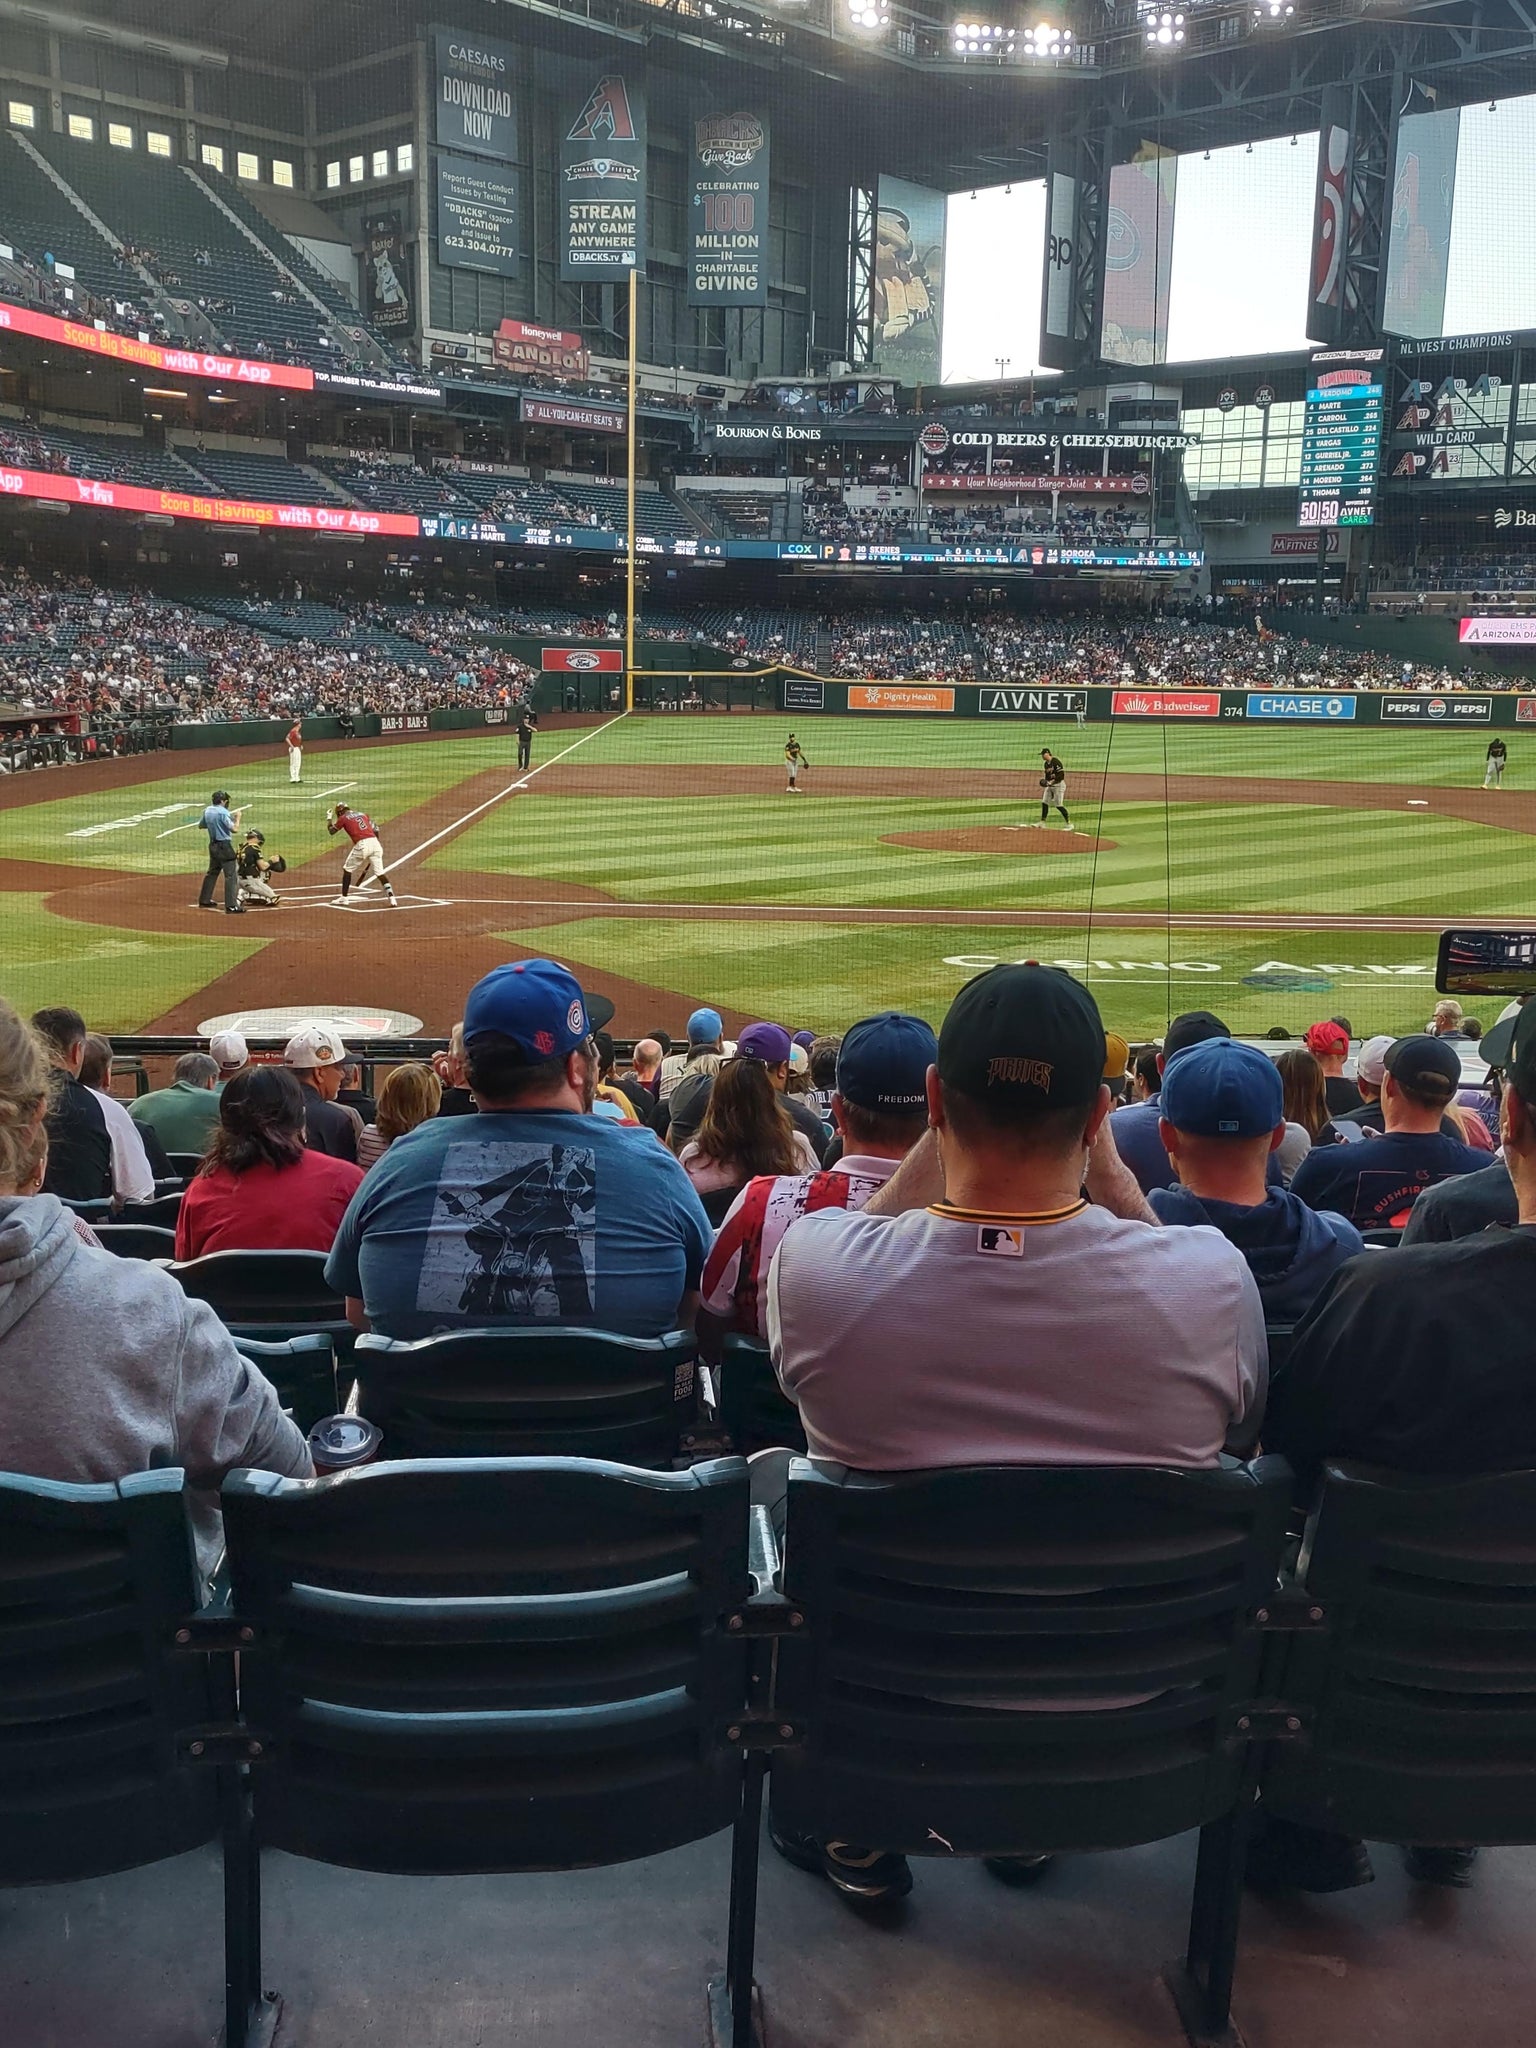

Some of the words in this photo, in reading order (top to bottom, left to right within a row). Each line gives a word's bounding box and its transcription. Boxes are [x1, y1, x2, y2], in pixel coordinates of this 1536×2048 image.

[449, 44, 505, 71] CAESARS
[443, 75, 511, 117] DOWNLOAD
[464, 109, 492, 141] NOW
[702, 149, 725, 166] Give
[723, 148, 753, 165] Back
[611, 166, 632, 174] FIELD
[442, 171, 466, 184] Report
[467, 177, 486, 189] Guest
[487, 181, 514, 195] Conduct
[696, 182, 760, 190] CELEBRATING
[451, 184, 472, 196] Issues
[473, 189, 481, 199] by
[483, 191, 507, 205] Texting
[445, 202, 488, 218] "DBACKS"
[569, 205, 636, 219] STREAM
[459, 216, 500, 232] LOCATION
[569, 222, 597, 233] ANY
[600, 222, 636, 233] GAME
[461, 228, 473, 236] and
[474, 231, 492, 241] issue
[493, 234, 501, 243] to
[444, 235, 514, 258] 623.304.0777
[569, 236, 636, 247] ANYWHERE
[695, 235, 759, 248] MILLION
[572, 253, 620, 262] DBACKS.TV
[721, 251, 733, 260] IN
[695, 264, 759, 272] CHARITABLE
[695, 275, 758, 290] GIVING
[521, 325, 562, 341] Honeywell
[1400, 344, 1413, 354] NL
[1417, 340, 1446, 353] WEST
[1449, 334, 1513, 350] CHAMPIONS
[64, 323, 97, 346] Score
[100, 334, 118, 355] Big
[121, 340, 163, 364] Savings
[164, 353, 198, 370] with
[203, 355, 234, 375] Our
[238, 361, 271, 382] App
[498, 340, 584, 370] SANDLOT
[1315, 351, 1347, 360] ARIZONA
[1349, 350, 1380, 358] SPORTS
[314, 372, 330, 383] TOP,
[331, 373, 360, 386] NUMBER
[1220, 391, 1235, 402] JOE
[1320, 388, 1353, 397] PERDOMO
[1318, 402, 1341, 410] MARTE
[538, 406, 593, 424] ALL-YOU-CAN-EAT
[593, 414, 613, 426] SEATS
[1317, 414, 1347, 422] CARROLL
[716, 424, 769, 439] BOURBON
[771, 426, 783, 439] &
[786, 426, 821, 440] BONES
[1329, 425, 1359, 434] CASTILLO
[952, 433, 993, 445] COLD
[996, 433, 1047, 447] BEERS
[1049, 434, 1060, 447] &
[1062, 434, 1198, 449] CHEESEBURGERS
[1316, 439, 1342, 447] VARGAS
[1416, 432, 1443, 445] WILD
[1446, 431, 1475, 443] CARD
[471, 463, 494, 473] BAR-S
[594, 476, 615, 486] BAR-S
[966, 477, 987, 489] Your
[987, 477, 1036, 489] Neighborhood
[1038, 478, 1064, 489] Burger
[1066, 478, 1087, 489] Joint
[1313, 476, 1342, 484] MORENO
[1312, 488, 1340, 496] THOMAS
[160, 493, 190, 512] Score
[193, 499, 212, 518] Big
[215, 503, 274, 522] Savings
[278, 508, 312, 525] with
[316, 508, 344, 526] Our
[348, 513, 380, 531] App
[1340, 506, 1374, 516] AVNET
[1342, 515, 1368, 524] CARES
[1514, 509, 1536, 526] Ba
[422, 518, 438, 529] DUE
[471, 523, 477, 531] 4
[480, 524, 497, 533] KETEL
[424, 527, 437, 537] UP
[460, 525, 466, 535] 2
[480, 532, 506, 542] MARTE
[617, 537, 624, 547] 3
[635, 543, 665, 553] CARROLL
[788, 544, 812, 554] COX
[856, 545, 867, 553] 30
[869, 546, 901, 554] SKENES
[955, 547, 962, 555] 0
[975, 547, 981, 555] 0
[996, 547, 1002, 555] 0
[1286, 541, 1319, 550] FITNES
[1060, 549, 1096, 557] SOROKA
[1187, 551, 1197, 559] 14
[1482, 631, 1521, 639] ARIZONA
[575, 658, 590, 667] Ford
[883, 692, 910, 703] Dignity
[911, 692, 937, 701] Health
[991, 692, 1077, 711] AVNET
[1153, 700, 1210, 712] Budweiser
[1224, 706, 1243, 717] 374
[1260, 699, 1323, 714] CHASE
[1387, 704, 1420, 713] PEPSI
[1453, 704, 1487, 714] PEPSI
[381, 716, 403, 730] BAR-S
[406, 715, 428, 729] BAR-S
[356, 816, 367, 831] 2
[1251, 961, 1437, 975] ARIZ
[987, 1056, 1055, 1095] PIRATES
[878, 1094, 925, 1104] FREEDOM
[1374, 1185, 1426, 1213] BUSHFIR
[674, 1385, 693, 1397] FOOD
